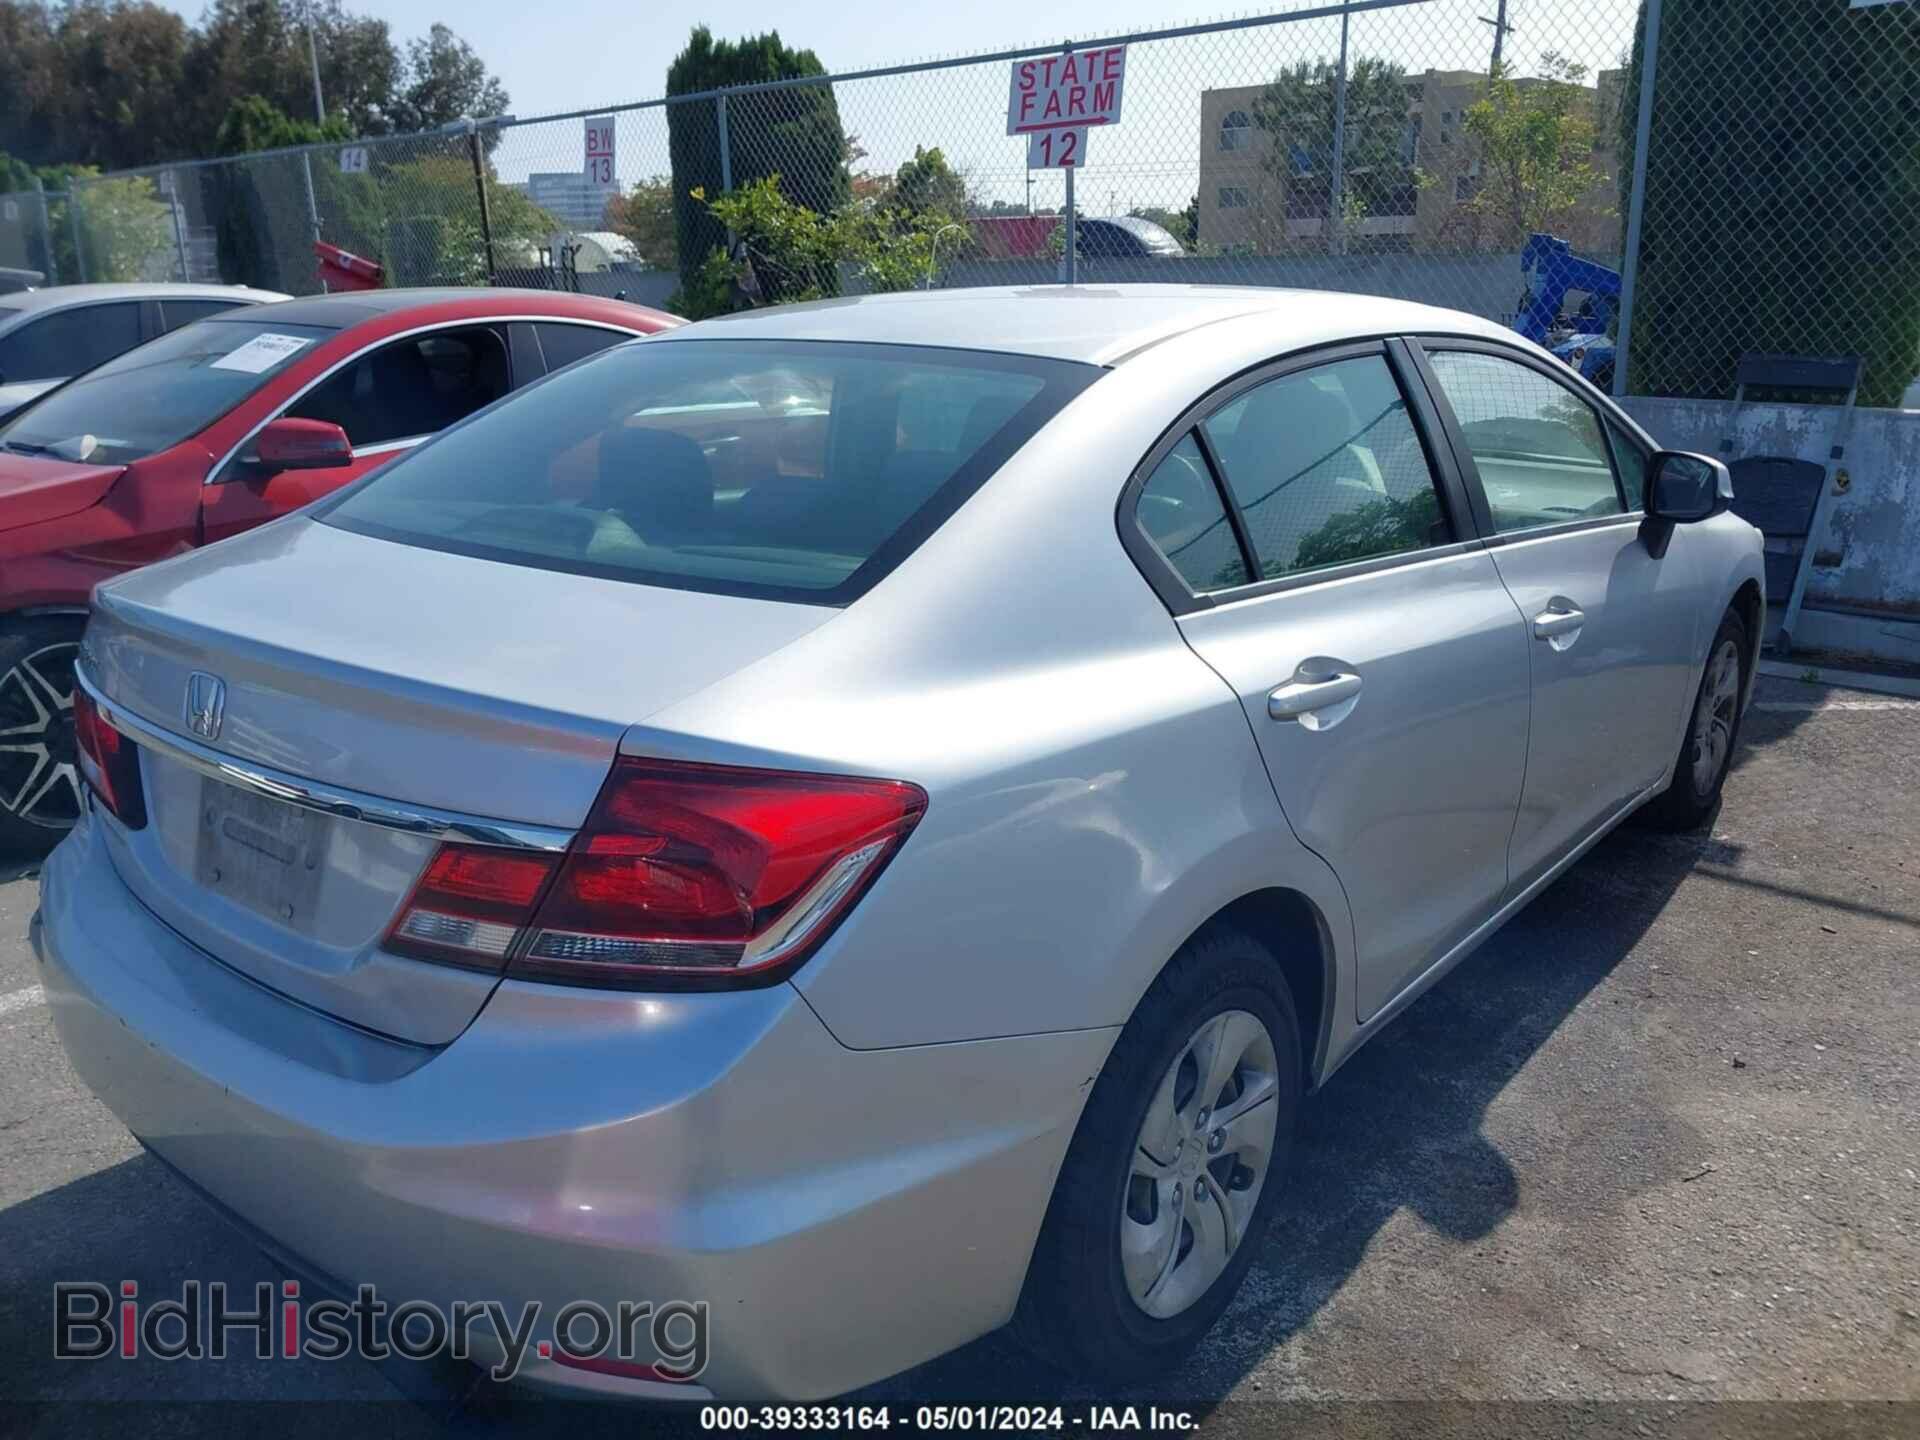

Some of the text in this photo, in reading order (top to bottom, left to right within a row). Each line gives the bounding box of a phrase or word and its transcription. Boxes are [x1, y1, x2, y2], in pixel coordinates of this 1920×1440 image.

[1019, 47, 1122, 91] STATE
[1020, 81, 1115, 121] FARM
[587, 127, 613, 151] BW
[1040, 131, 1077, 167] 12
[591, 158, 611, 183] 13
